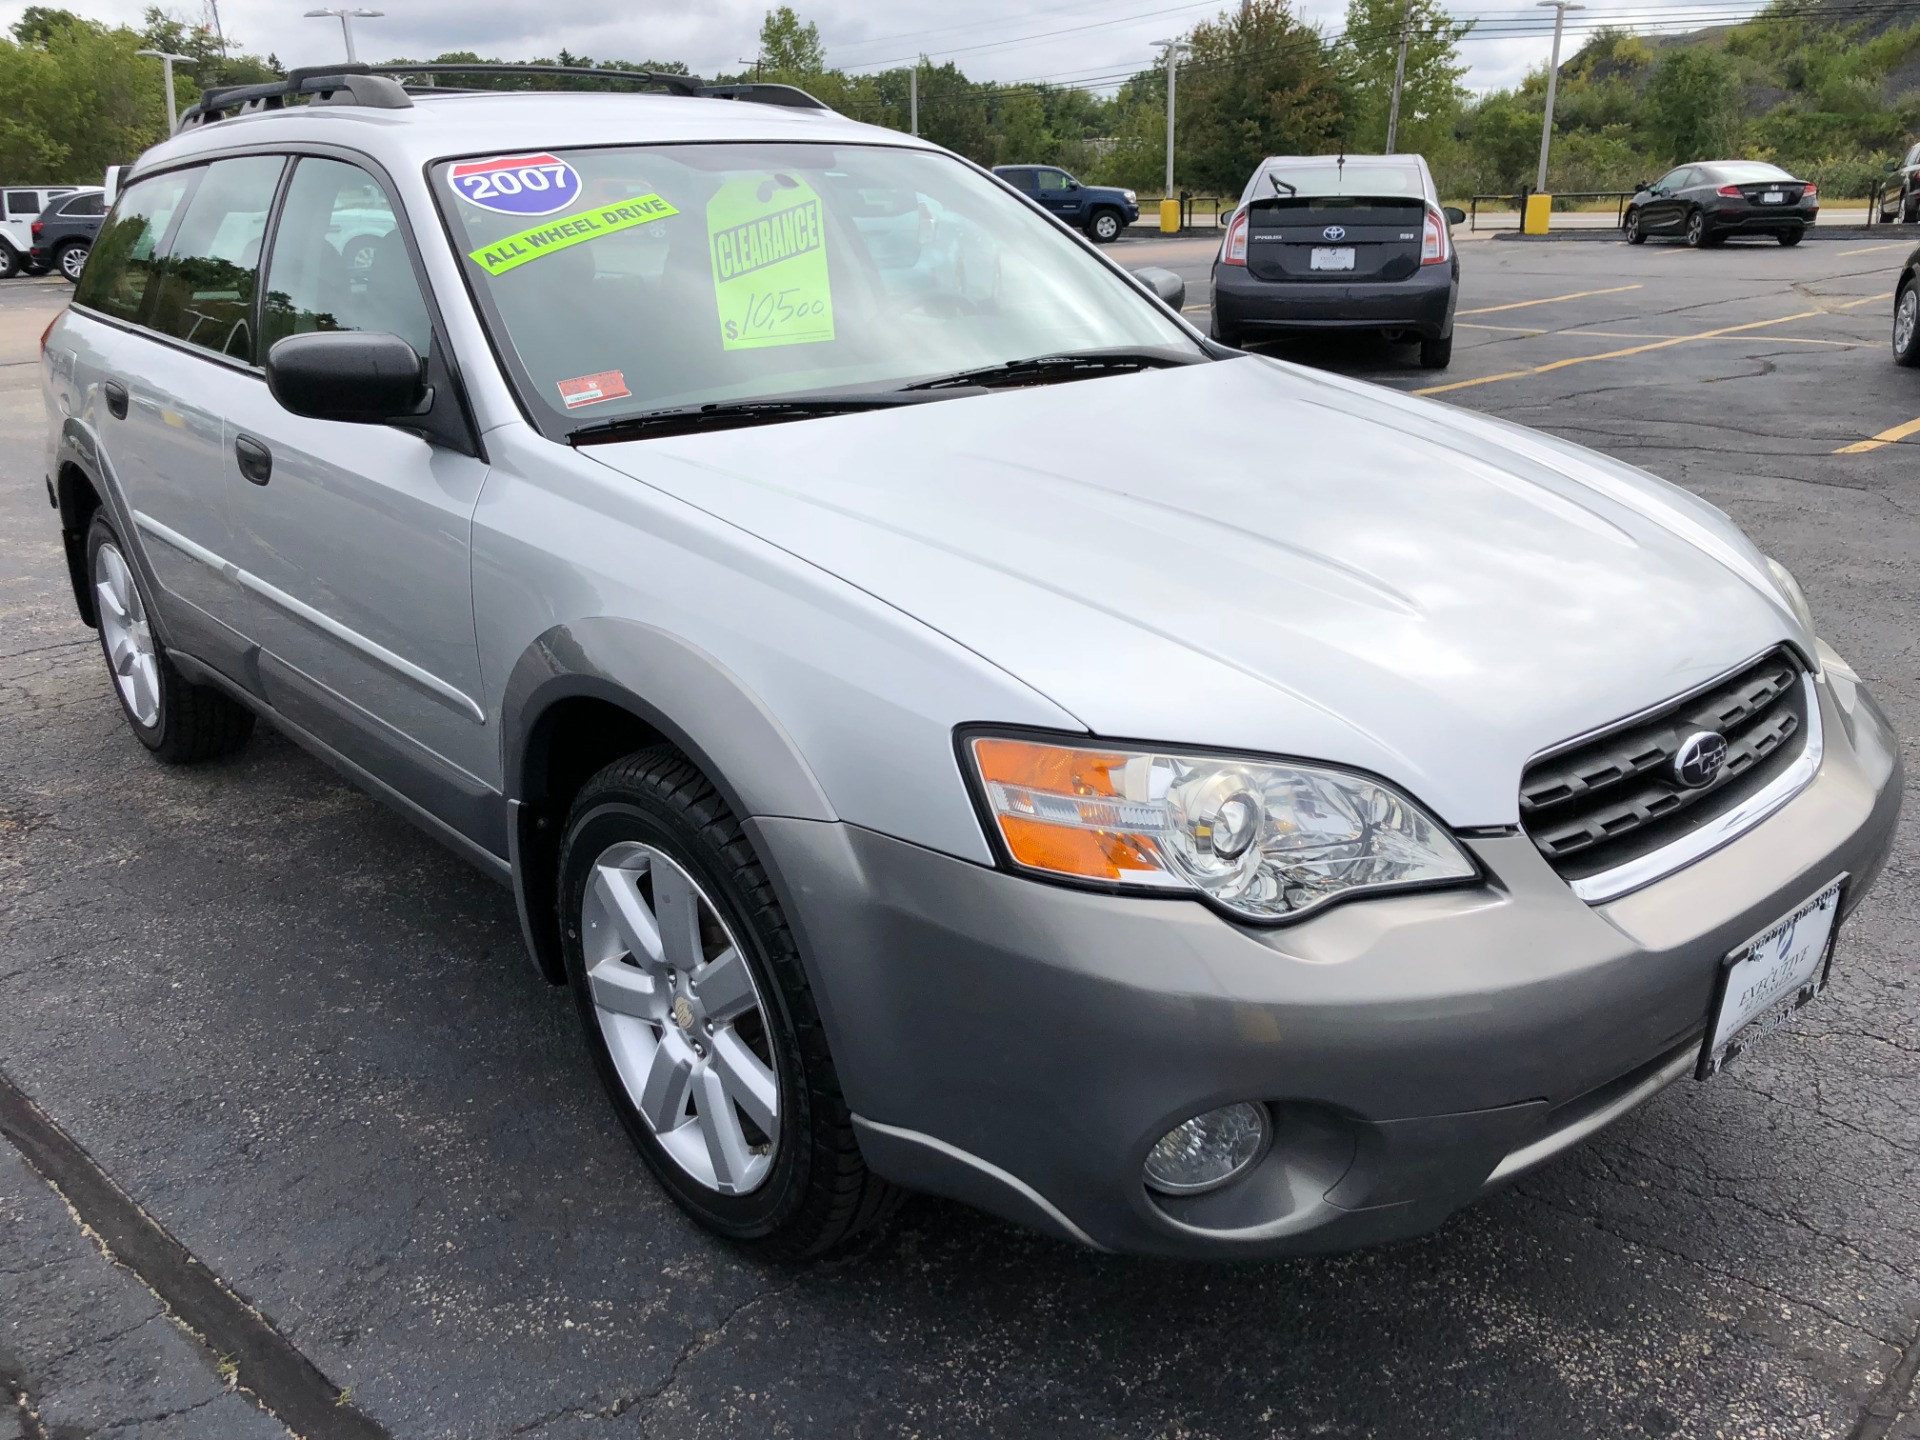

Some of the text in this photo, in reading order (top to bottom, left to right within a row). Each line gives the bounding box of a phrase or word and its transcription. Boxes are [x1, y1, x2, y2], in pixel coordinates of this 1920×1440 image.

[464, 166, 566, 199] 2007
[483, 199, 668, 267] ALL WHEEL DRIVE
[717, 204, 819, 278] CLEARANCE
